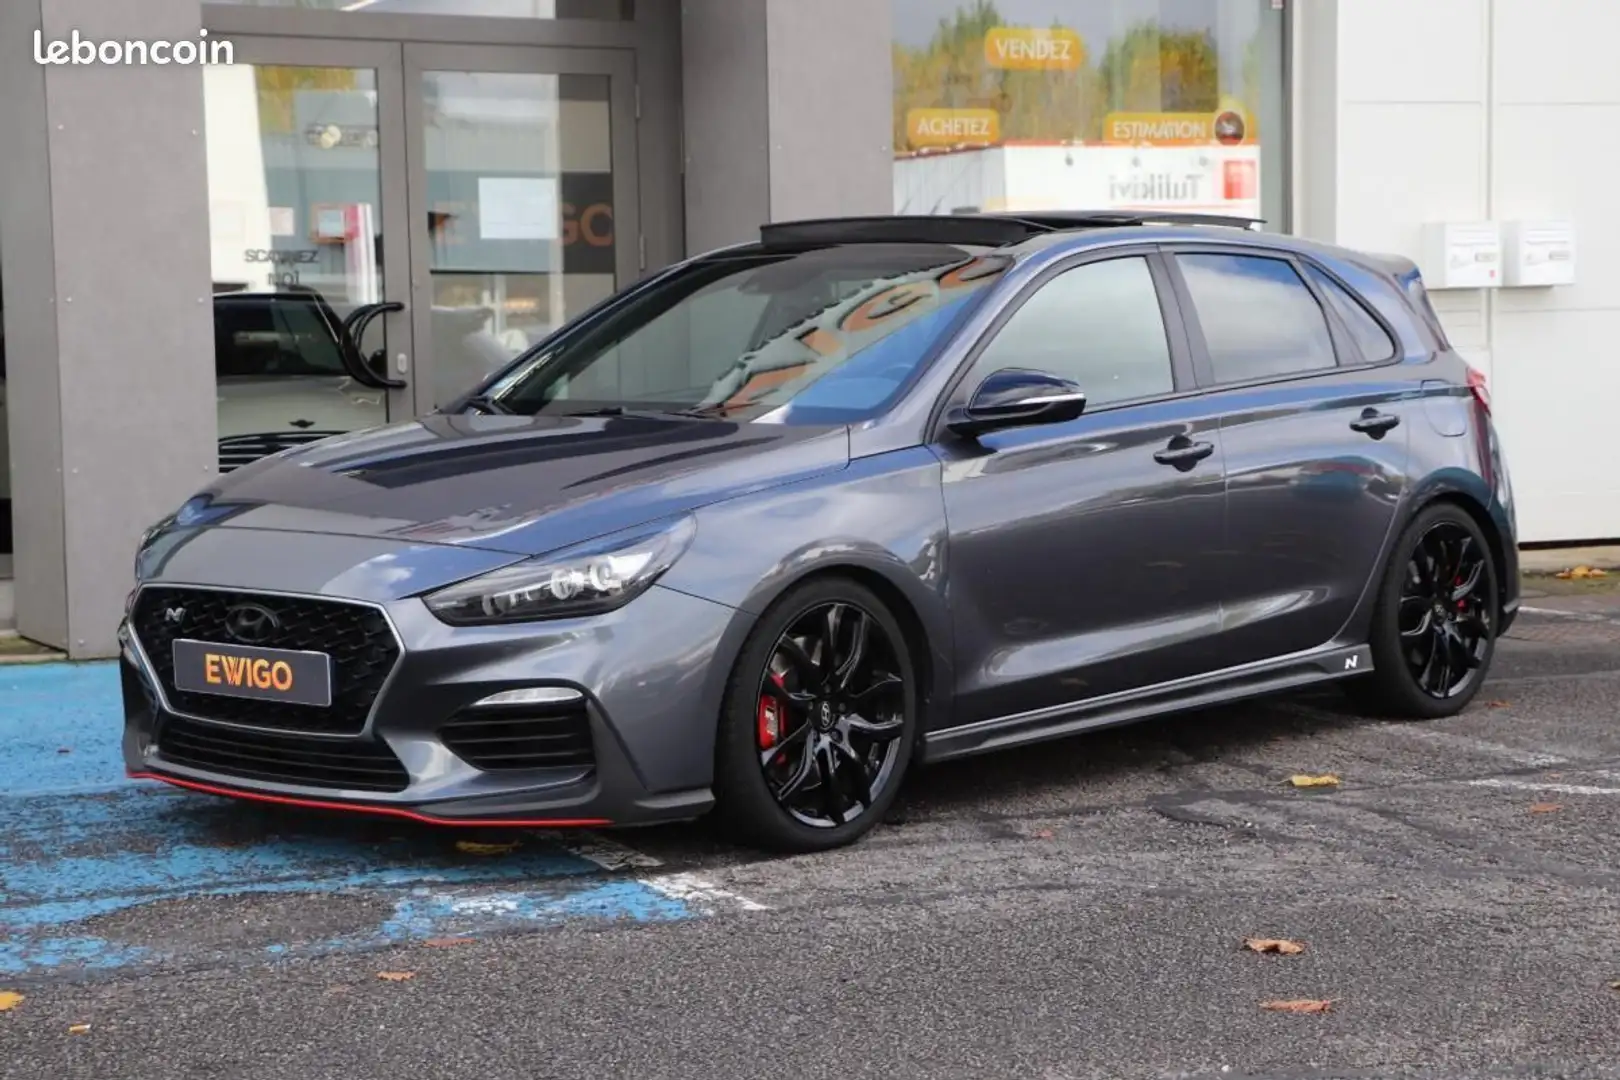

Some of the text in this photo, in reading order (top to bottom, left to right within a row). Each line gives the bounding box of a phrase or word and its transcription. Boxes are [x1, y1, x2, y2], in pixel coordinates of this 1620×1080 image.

[996, 39, 1073, 61] VENDEZ
[917, 116, 991, 136] ACHETEZ
[1112, 119, 1206, 140] ESTIMATION
[205, 652, 293, 691] EWIGO
[1344, 654, 1359, 670] N
